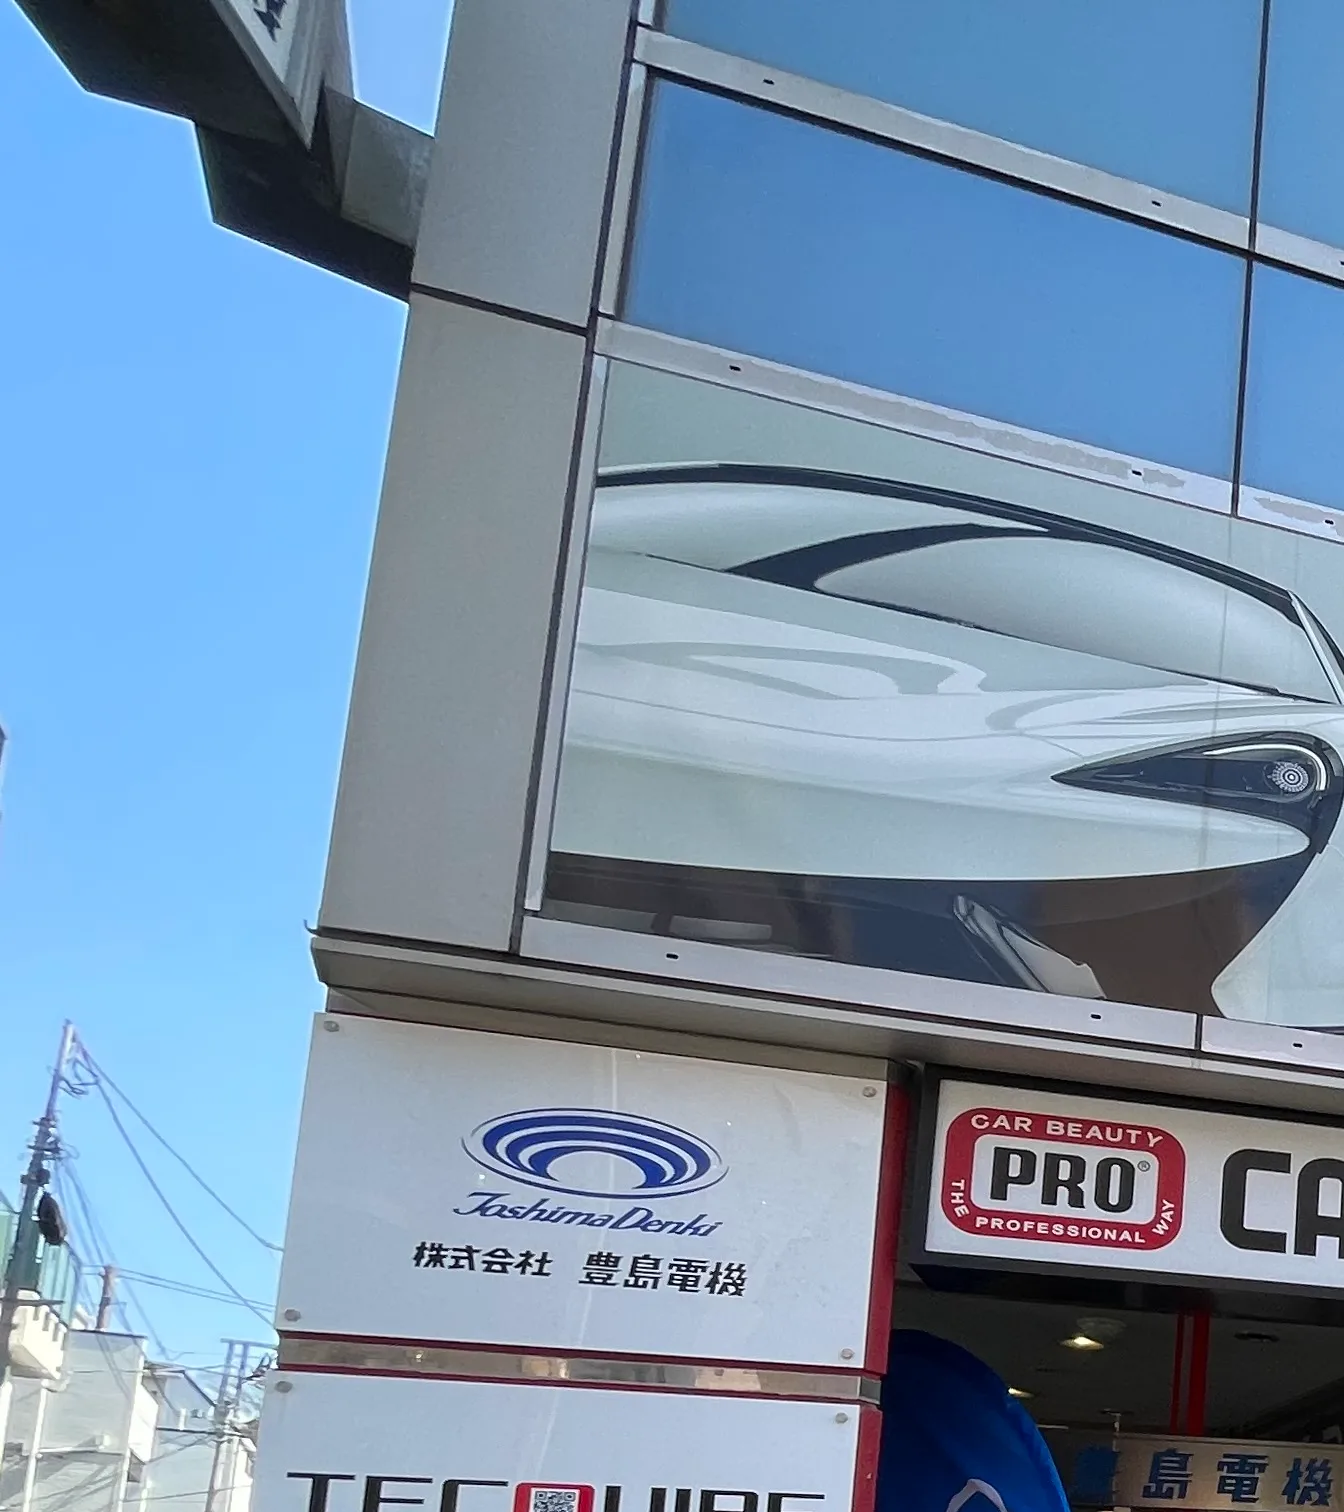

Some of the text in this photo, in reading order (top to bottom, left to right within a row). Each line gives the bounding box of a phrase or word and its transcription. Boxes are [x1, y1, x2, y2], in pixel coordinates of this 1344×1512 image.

[970, 1113, 1164, 1149] CAR BEAUTY
[990, 1145, 1137, 1214] PRO
[950, 1178, 1176, 1245] THE PROFESSIONAL WAY
[412, 1241, 748, 1298] 株式会社 豊島電機
